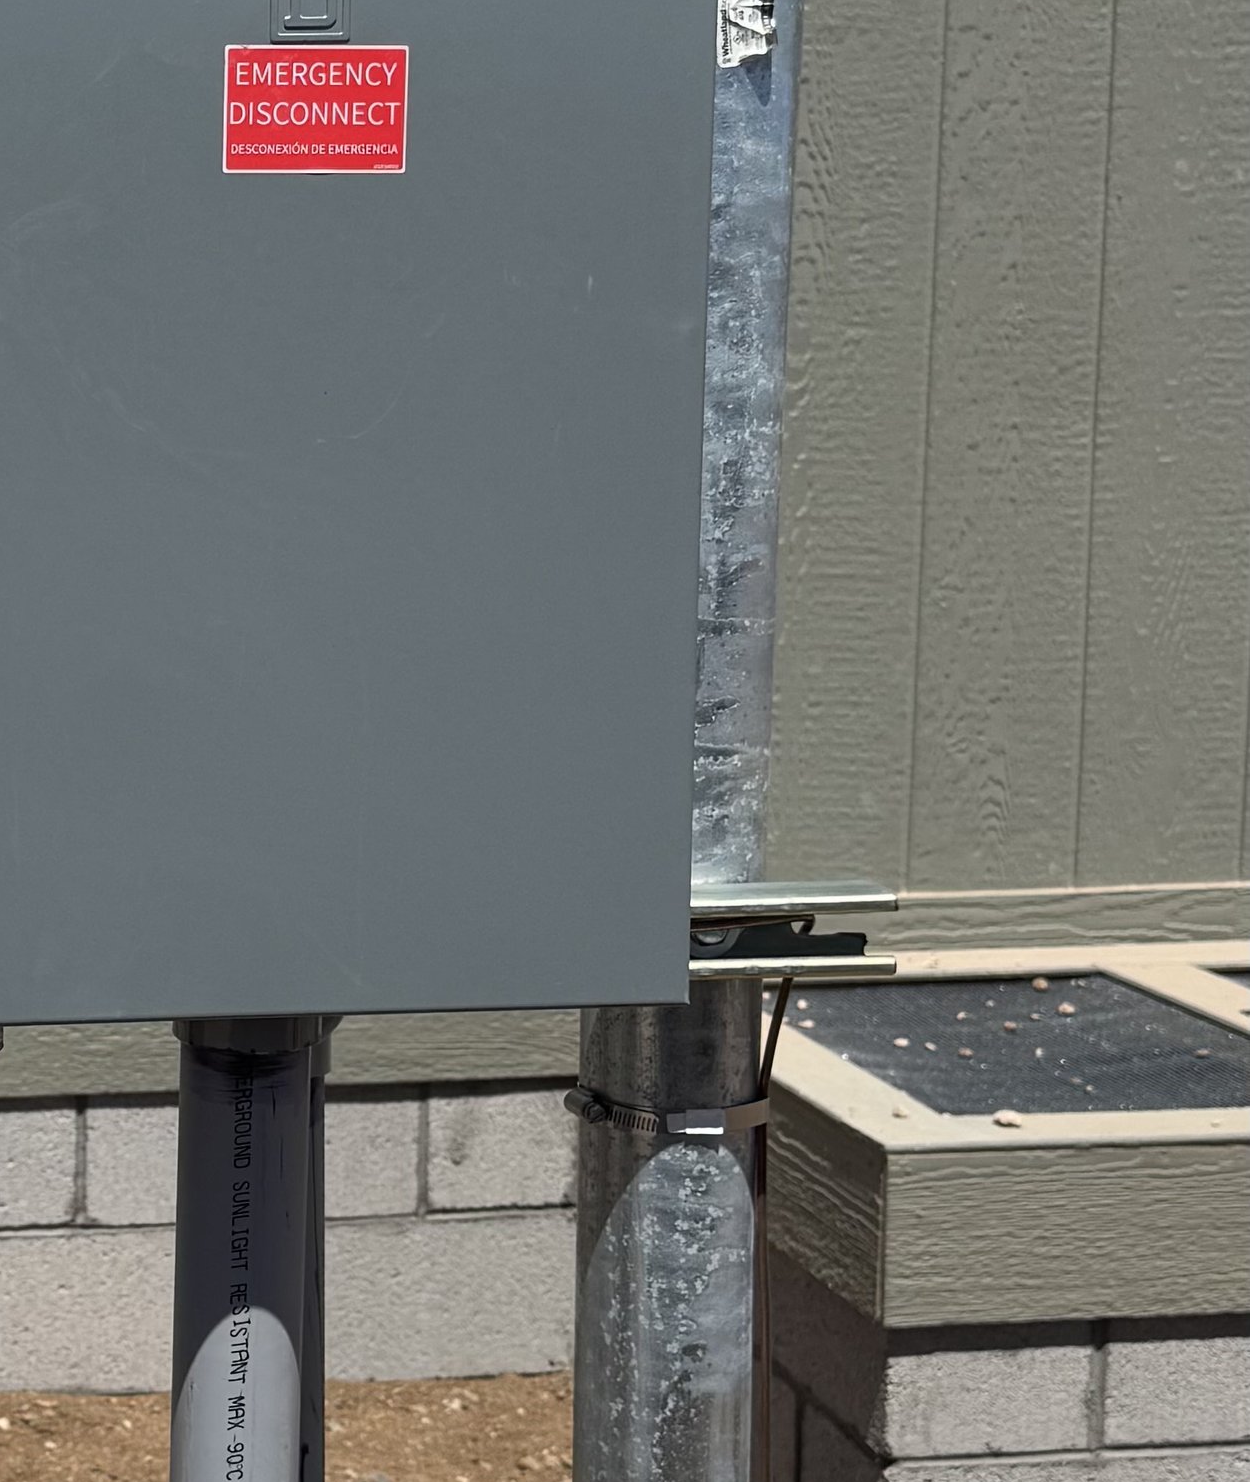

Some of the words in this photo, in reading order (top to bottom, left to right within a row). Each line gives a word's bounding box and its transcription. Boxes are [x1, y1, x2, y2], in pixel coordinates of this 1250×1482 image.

[720, 9, 730, 58] Wheatland
[236, 62, 398, 86] EMERGENCY
[229, 101, 401, 126] DISCONNECT
[231, 142, 309, 155] DESCONEXIÓN
[311, 144, 325, 155] DE
[328, 144, 398, 155] EMERGENCIA
[233, 1070, 253, 1169] ERGROUND
[231, 1181, 250, 1271] SUNLIGHT
[228, 1283, 251, 1384] RESISTANT
[227, 1394, 246, 1431] MAX
